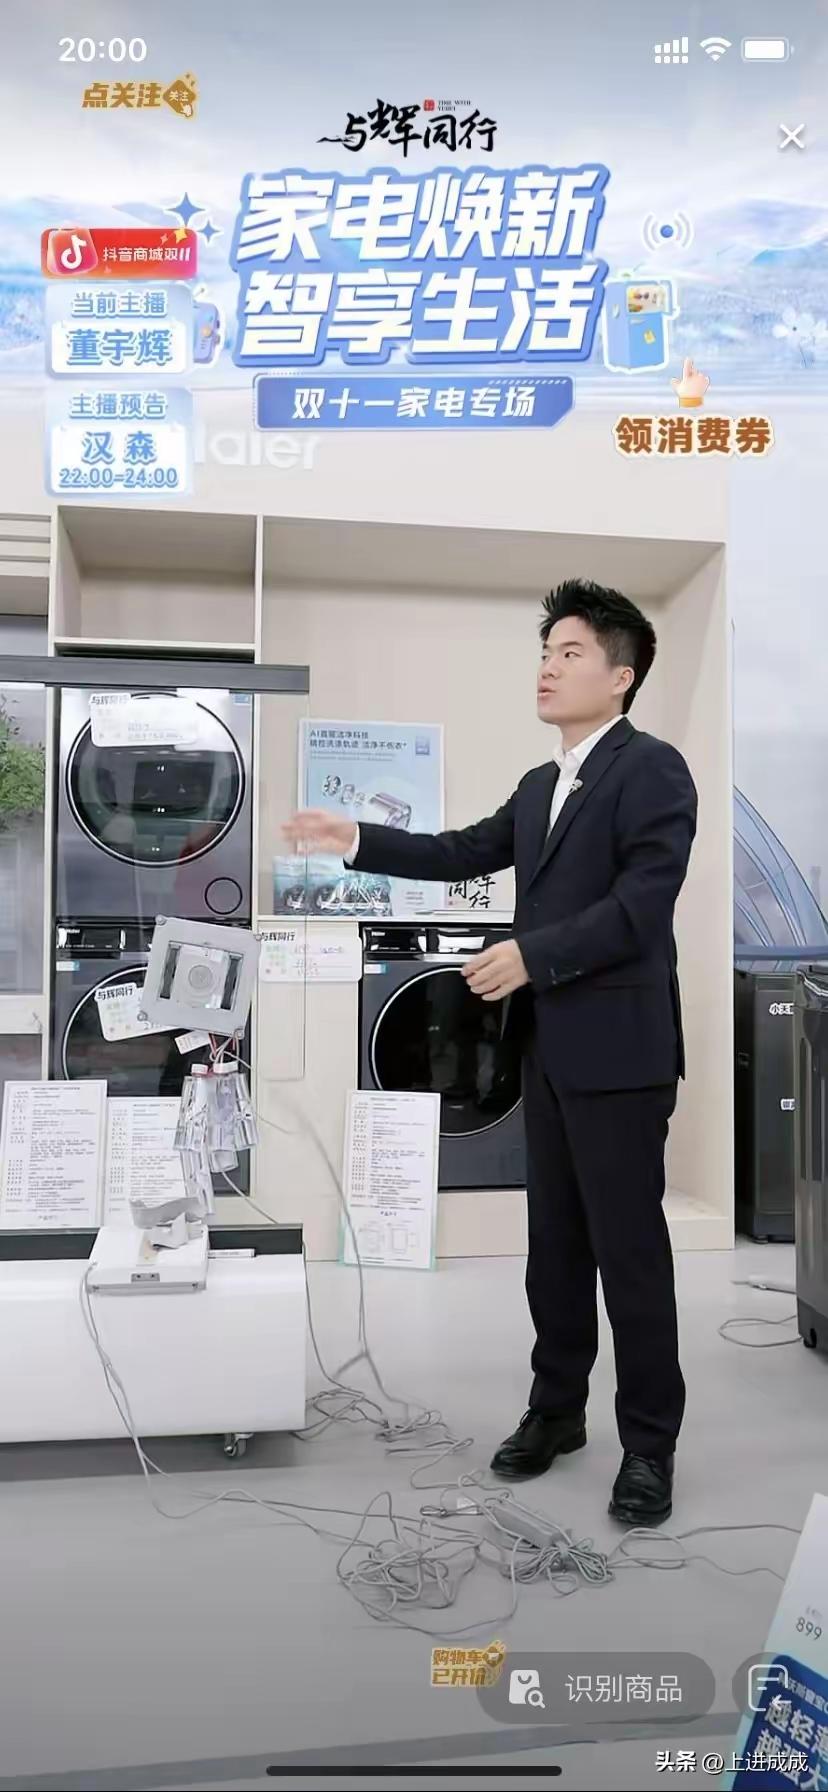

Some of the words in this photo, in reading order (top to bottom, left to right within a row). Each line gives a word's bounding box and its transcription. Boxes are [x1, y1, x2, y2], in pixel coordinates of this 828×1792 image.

[193, 423, 322, 470] aier
[97, 985, 134, 1001] 与辉同行
[769, 1003, 794, 1015] 小天
[795, 1616, 822, 1641] 899
